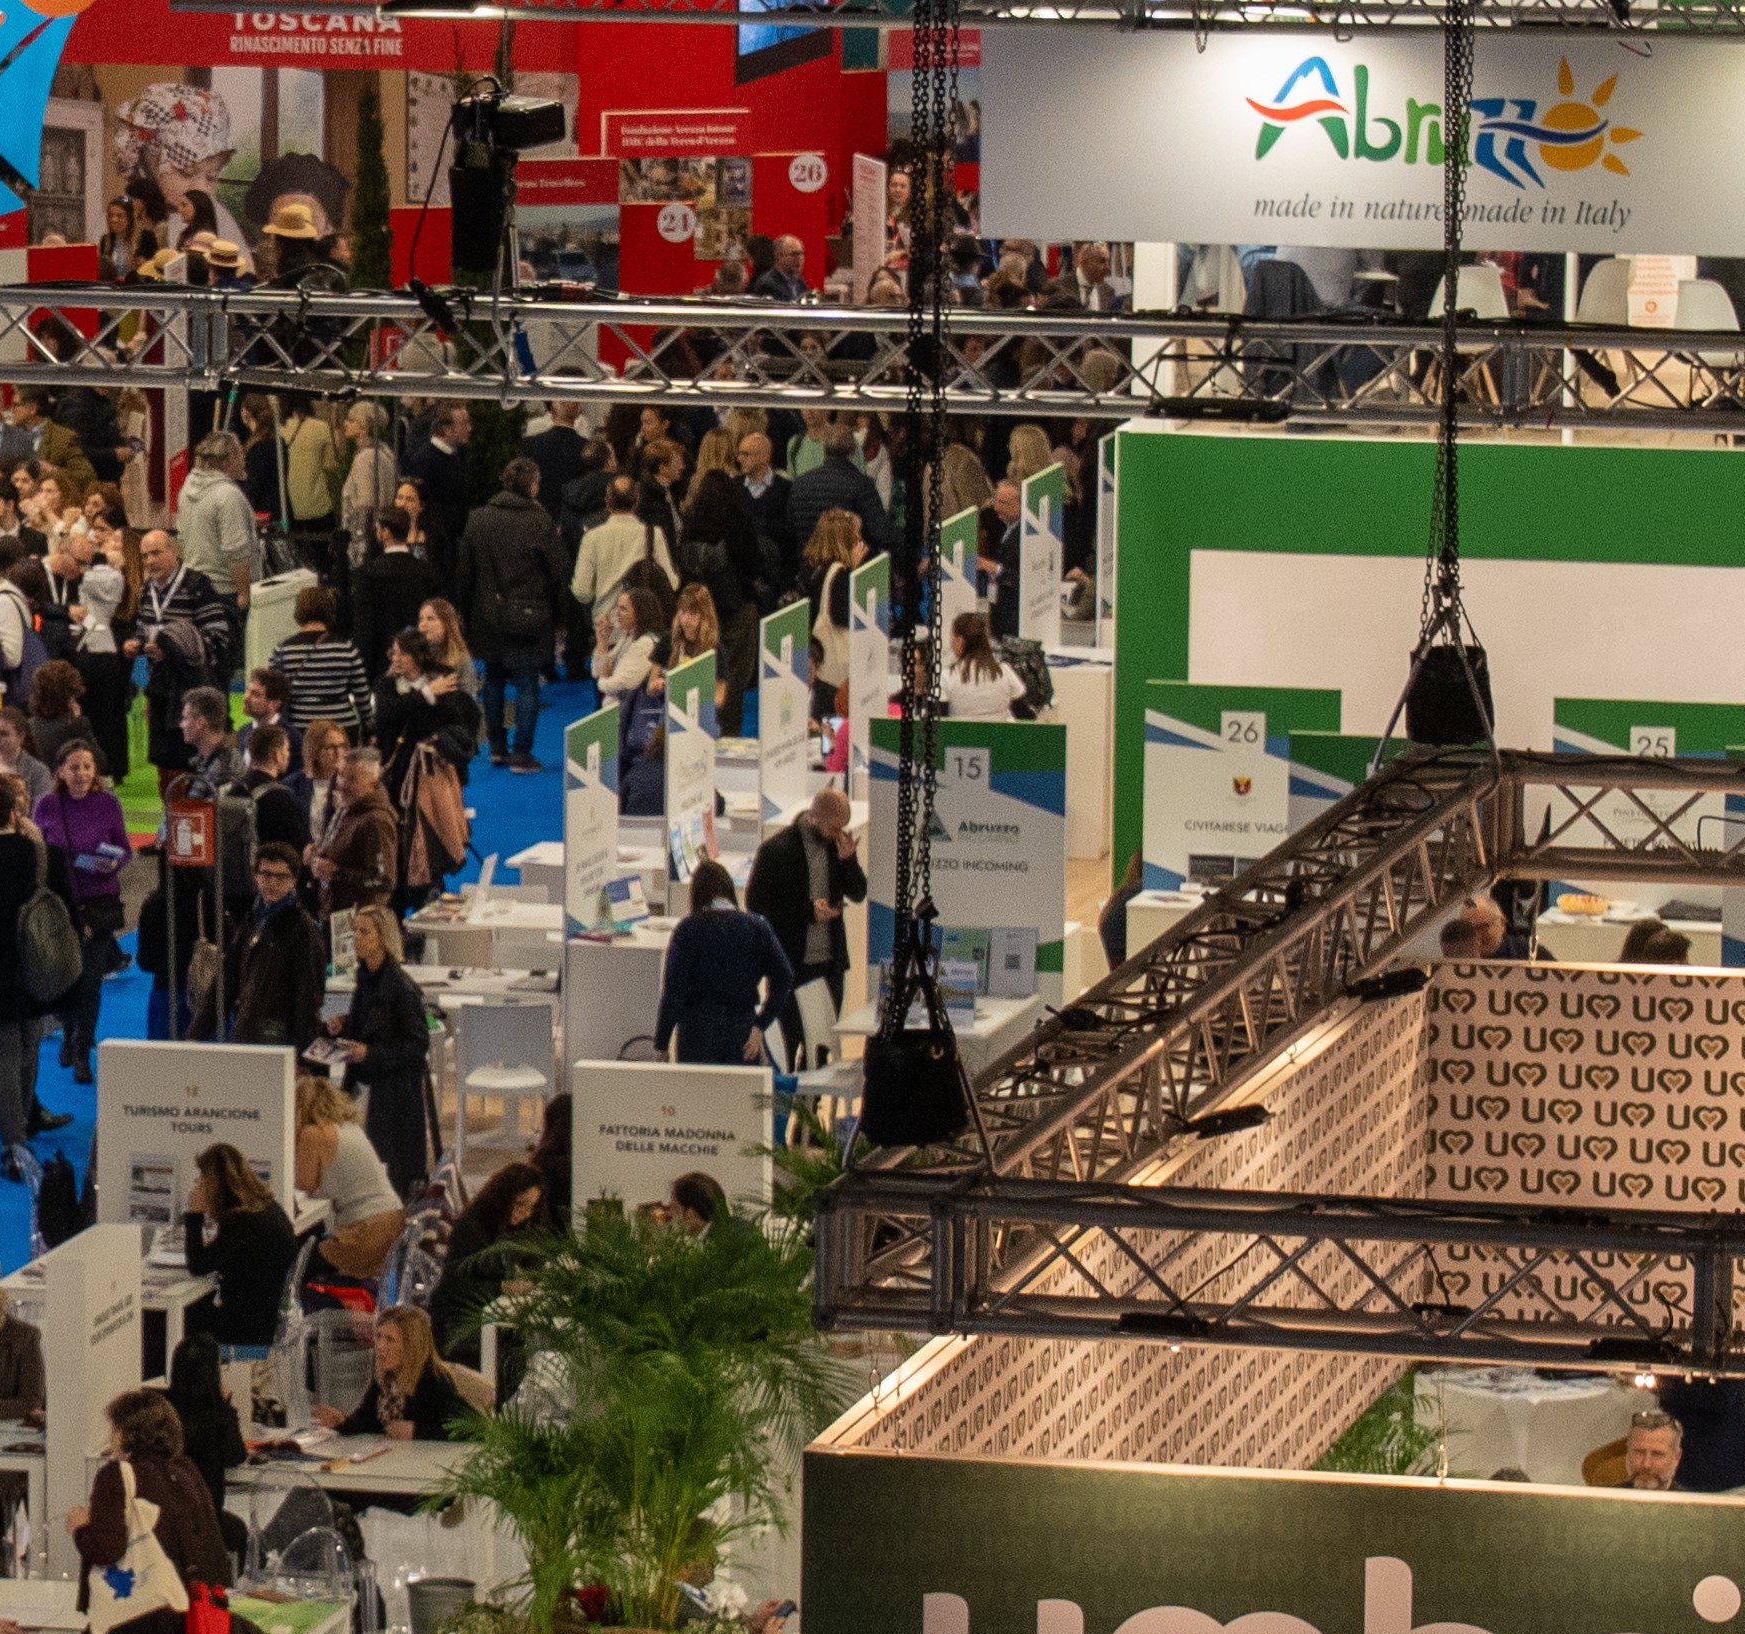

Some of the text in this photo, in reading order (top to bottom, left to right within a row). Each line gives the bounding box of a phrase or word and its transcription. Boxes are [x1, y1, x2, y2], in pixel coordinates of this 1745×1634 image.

[229, 35, 327, 54] RINASCIMENTO
[373, 38, 403, 56] FINE
[1254, 193, 1321, 220] made
[1330, 196, 1355, 220] in
[1536, 202, 1567, 226] in
[1575, 199, 1632, 233] Italy
[1228, 720, 1259, 743] 26
[1637, 735, 1669, 757] 25
[955, 757, 982, 780] 15
[958, 821, 1020, 836] Abruzzo
[1184, 819, 1250, 835] CIVITARESE
[962, 859, 1029, 873] INCOMING
[123, 1104, 261, 1121] TURISMO ARANCIONE
[172, 1121, 213, 1134] TOURS
[599, 1123, 736, 1142] FATTORIA MADONNA
[615, 1139, 719, 1157] DELLE MACCHIE
